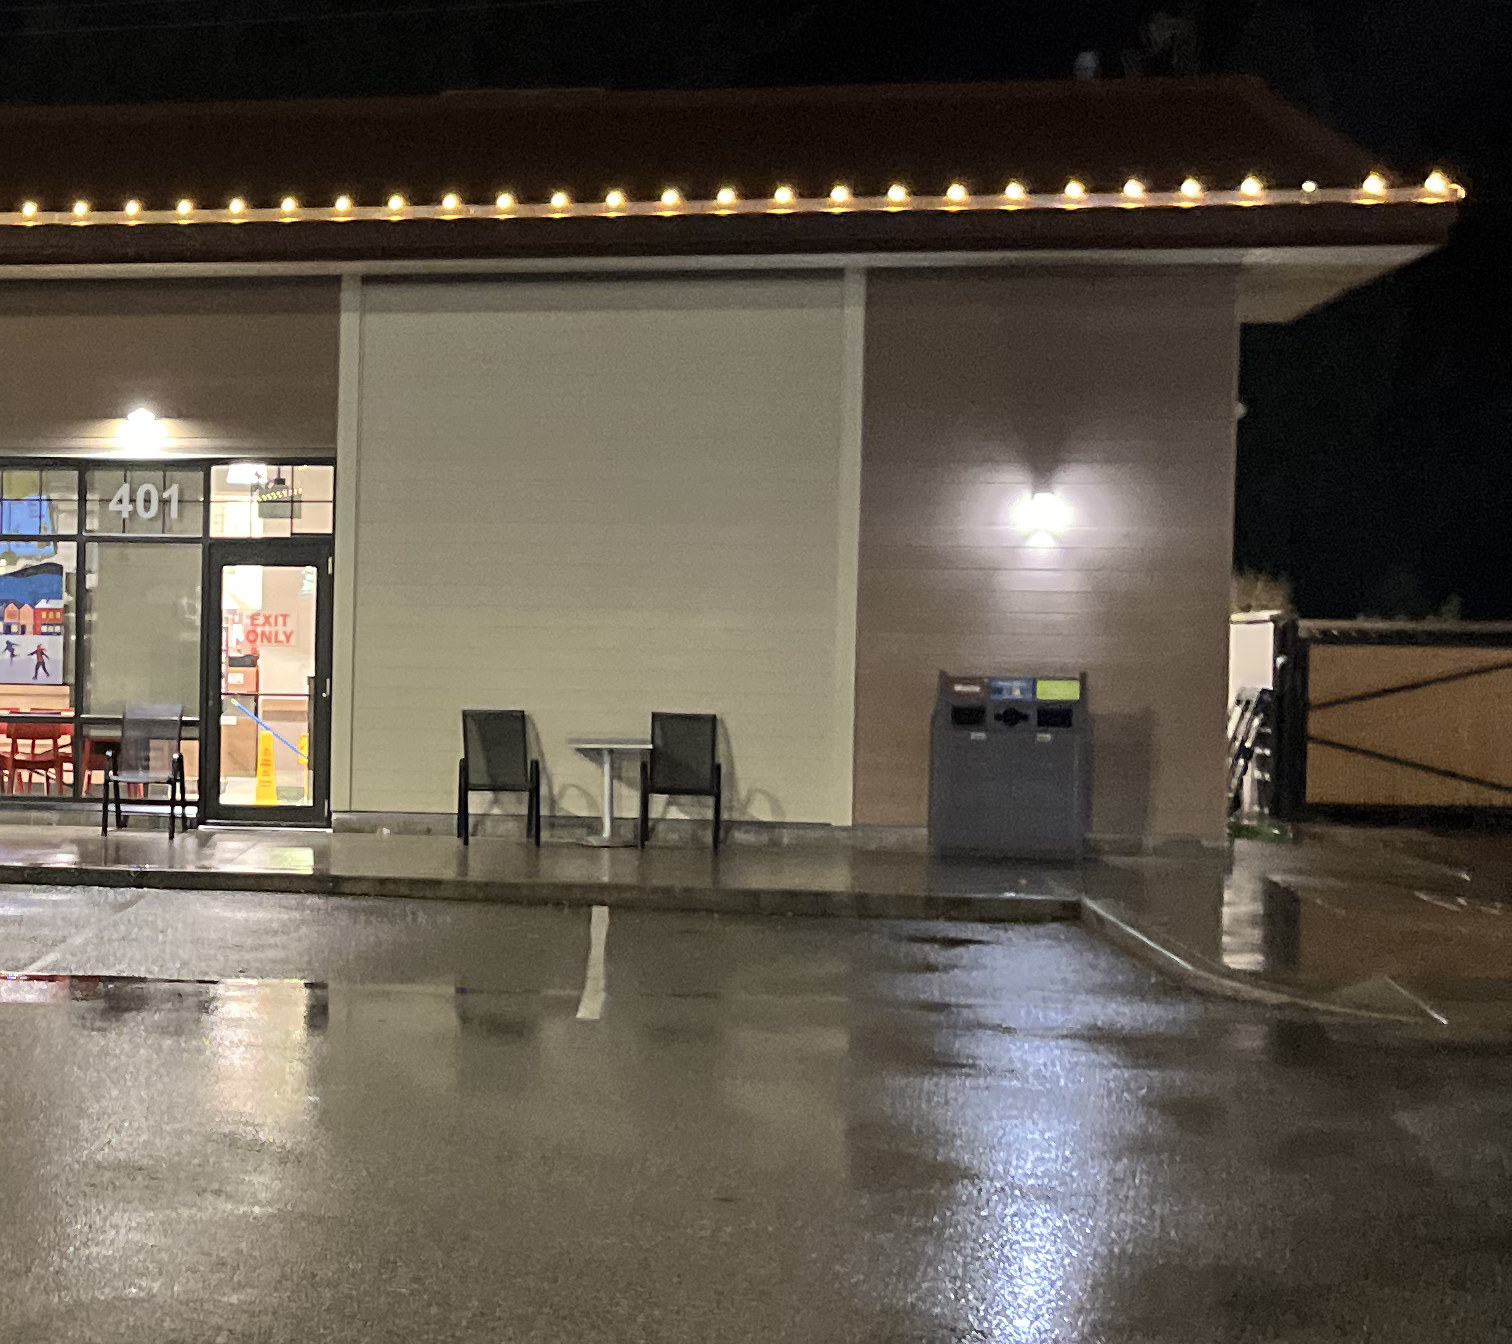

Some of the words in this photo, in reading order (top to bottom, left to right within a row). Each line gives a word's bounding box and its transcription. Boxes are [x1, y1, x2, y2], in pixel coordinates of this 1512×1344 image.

[108, 483, 180, 520] 401
[249, 612, 291, 627] EXIT
[245, 629, 295, 644] ONLY
